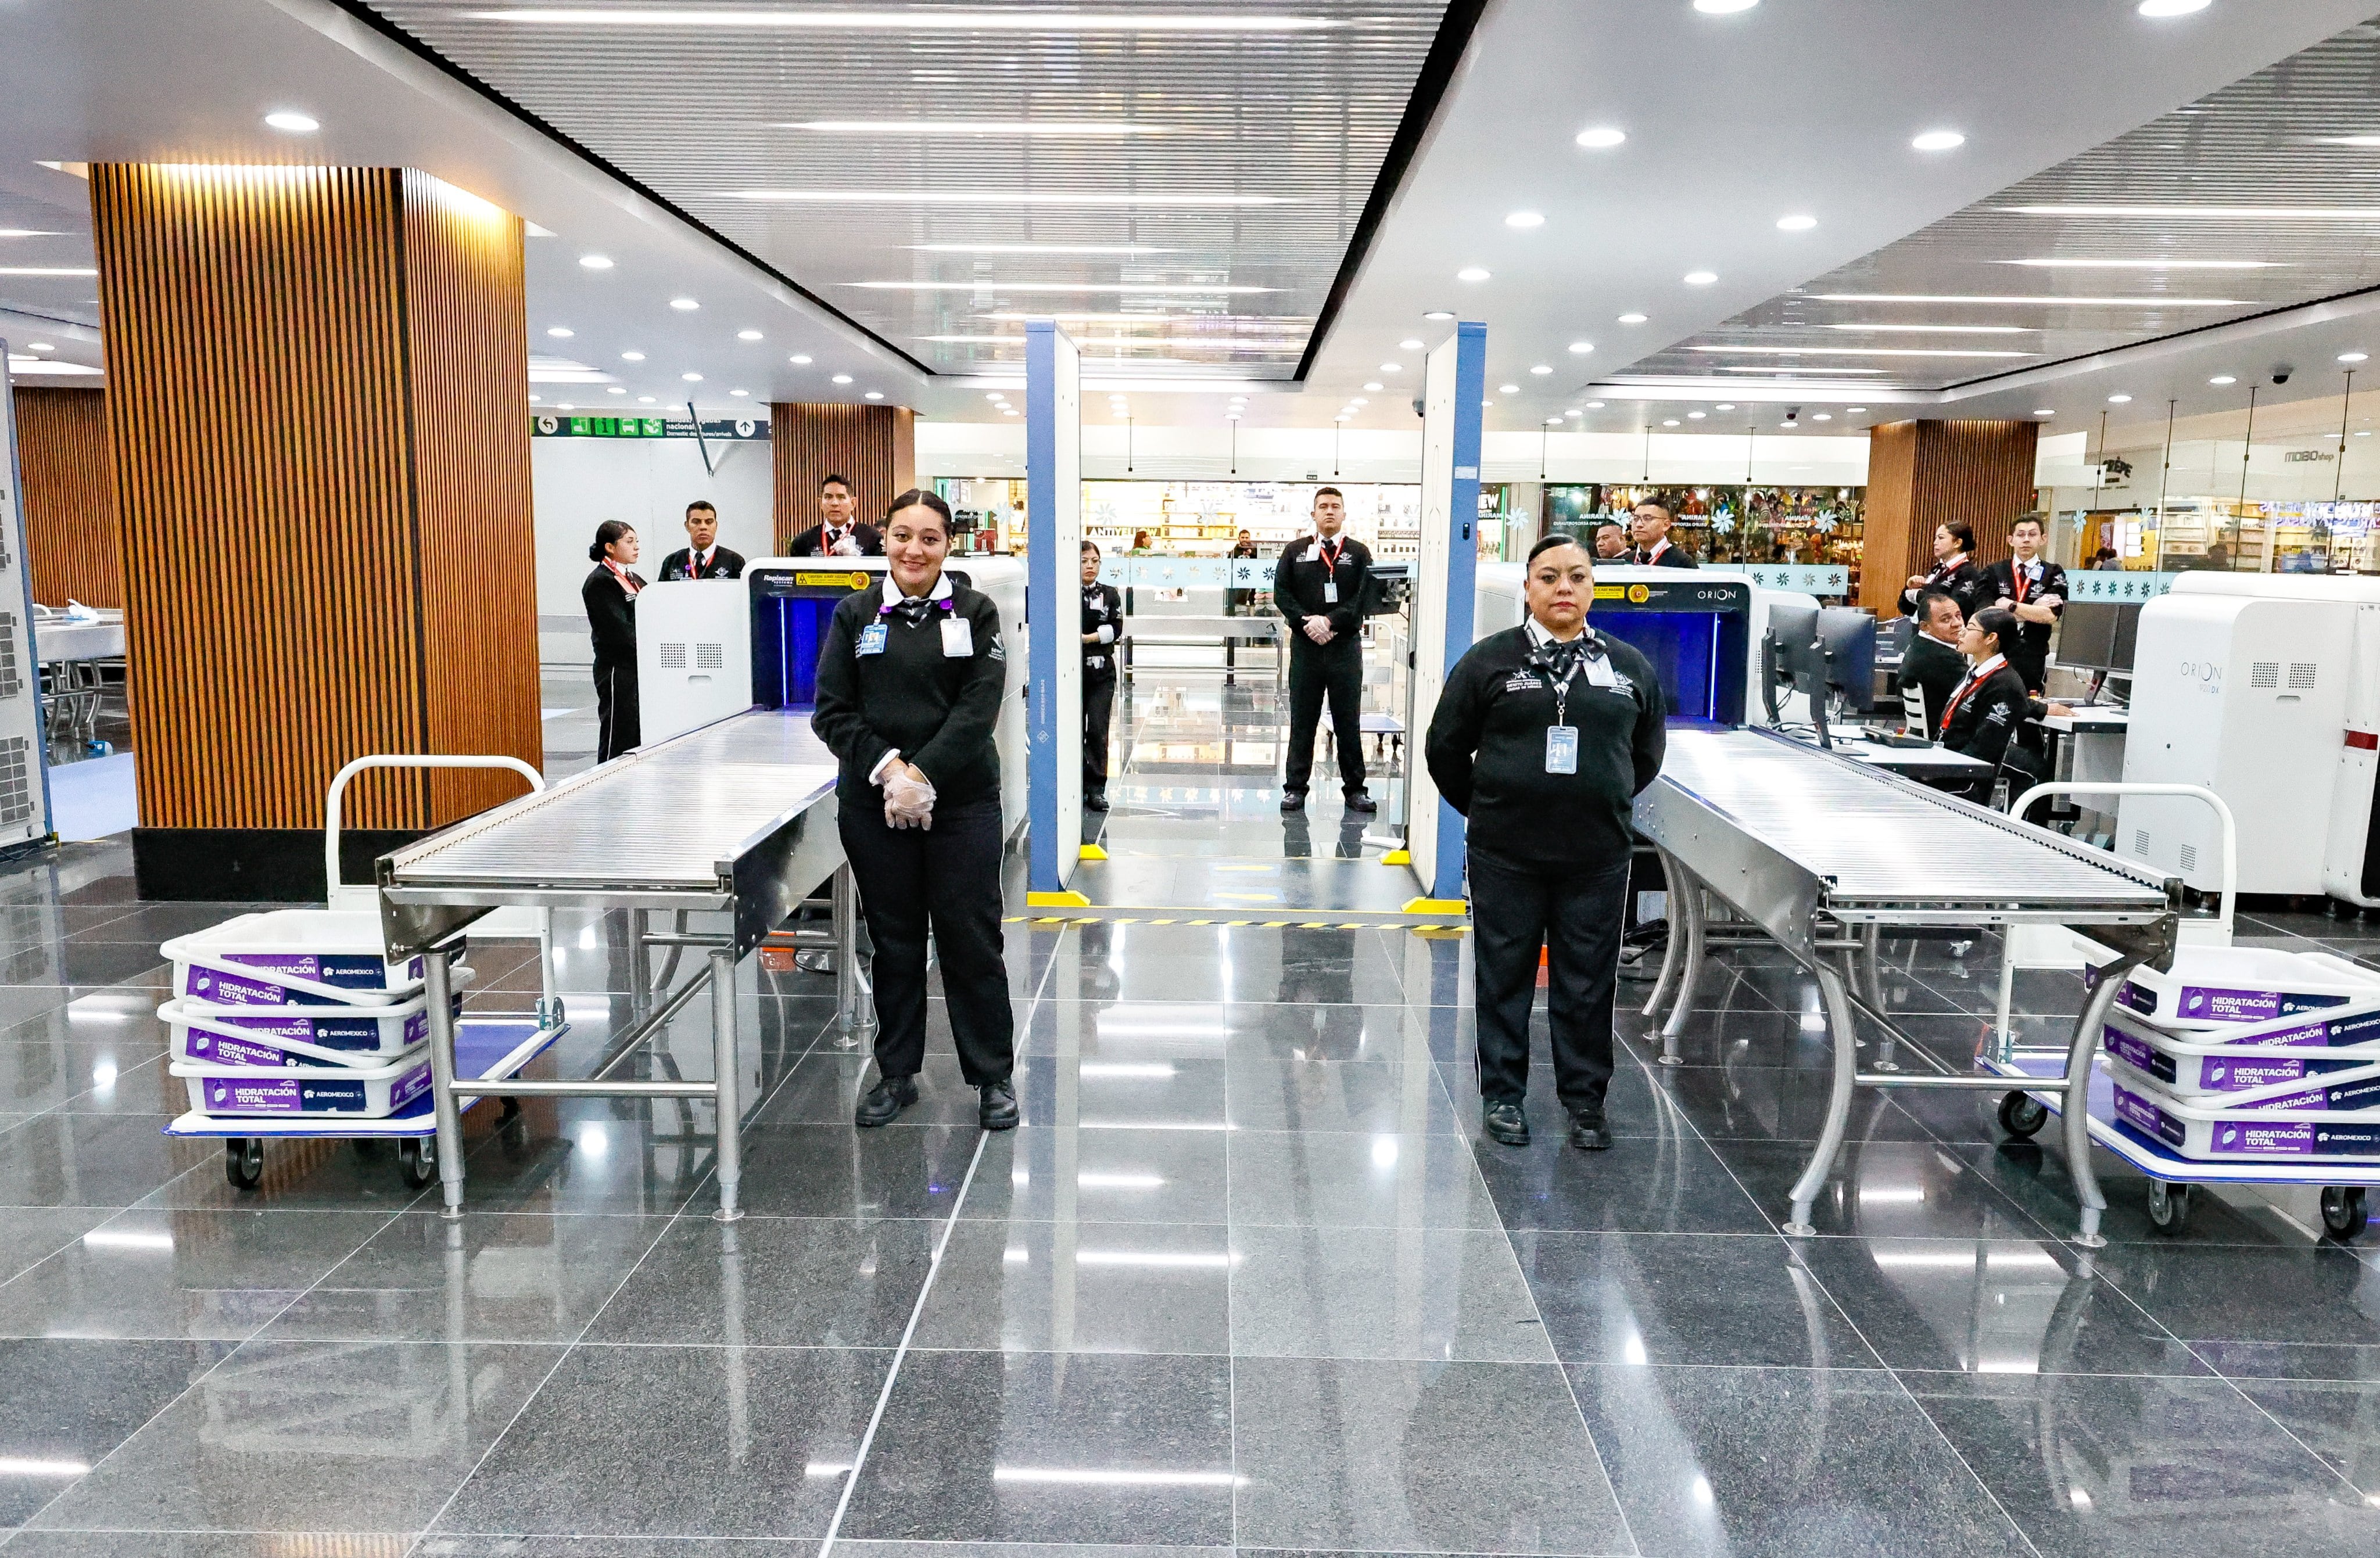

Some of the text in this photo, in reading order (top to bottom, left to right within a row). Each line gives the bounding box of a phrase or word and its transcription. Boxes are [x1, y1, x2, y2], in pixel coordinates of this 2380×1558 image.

[1697, 589, 1736, 601] ORION
[2181, 662, 2222, 681] ORION
[218, 981, 281, 1003] HIDRATACIÓN
[218, 989, 248, 1003] TOTAL
[2211, 996, 2277, 1008] HIDRATACIÓN
[2211, 1004, 2242, 1014] TOTAL
[2343, 1018, 2380, 1031] AEROMEXIC
[218, 1041, 279, 1061] HIDRATACIÓN
[218, 1048, 247, 1061] TOTAL
[2234, 1067, 2299, 1077] HIDRATACIÓN
[2234, 1076, 2264, 1084] TOTAL
[235, 1087, 297, 1097] HIDRATACIÓN
[2343, 1086, 2380, 1097] AEROMEXIC
[2245, 1129, 2311, 1139] HIDRATACIÓN
